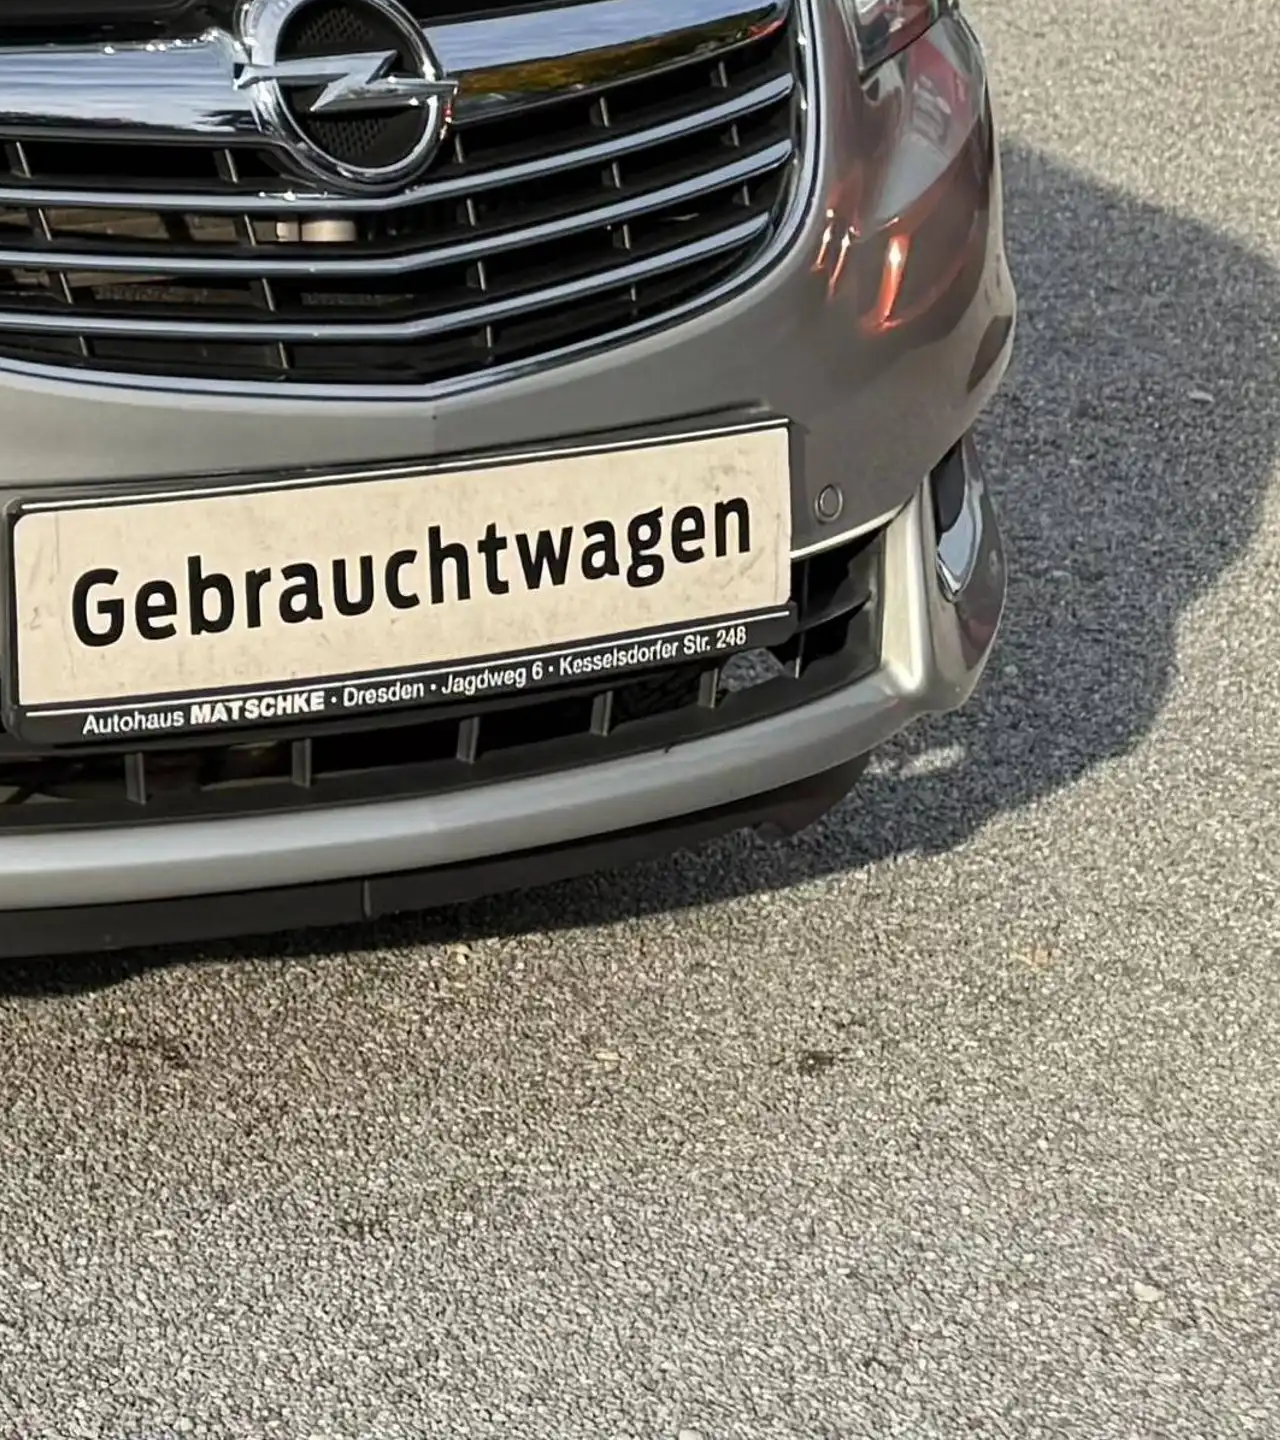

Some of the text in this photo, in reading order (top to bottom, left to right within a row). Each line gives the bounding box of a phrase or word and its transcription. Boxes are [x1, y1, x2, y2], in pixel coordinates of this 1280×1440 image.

[71, 495, 752, 647] Gebrauchtwagen
[82, 625, 746, 735] Autohaus MATSCHKE Dresden Jagdweg 6 Kesselsdorfer Str. 248
